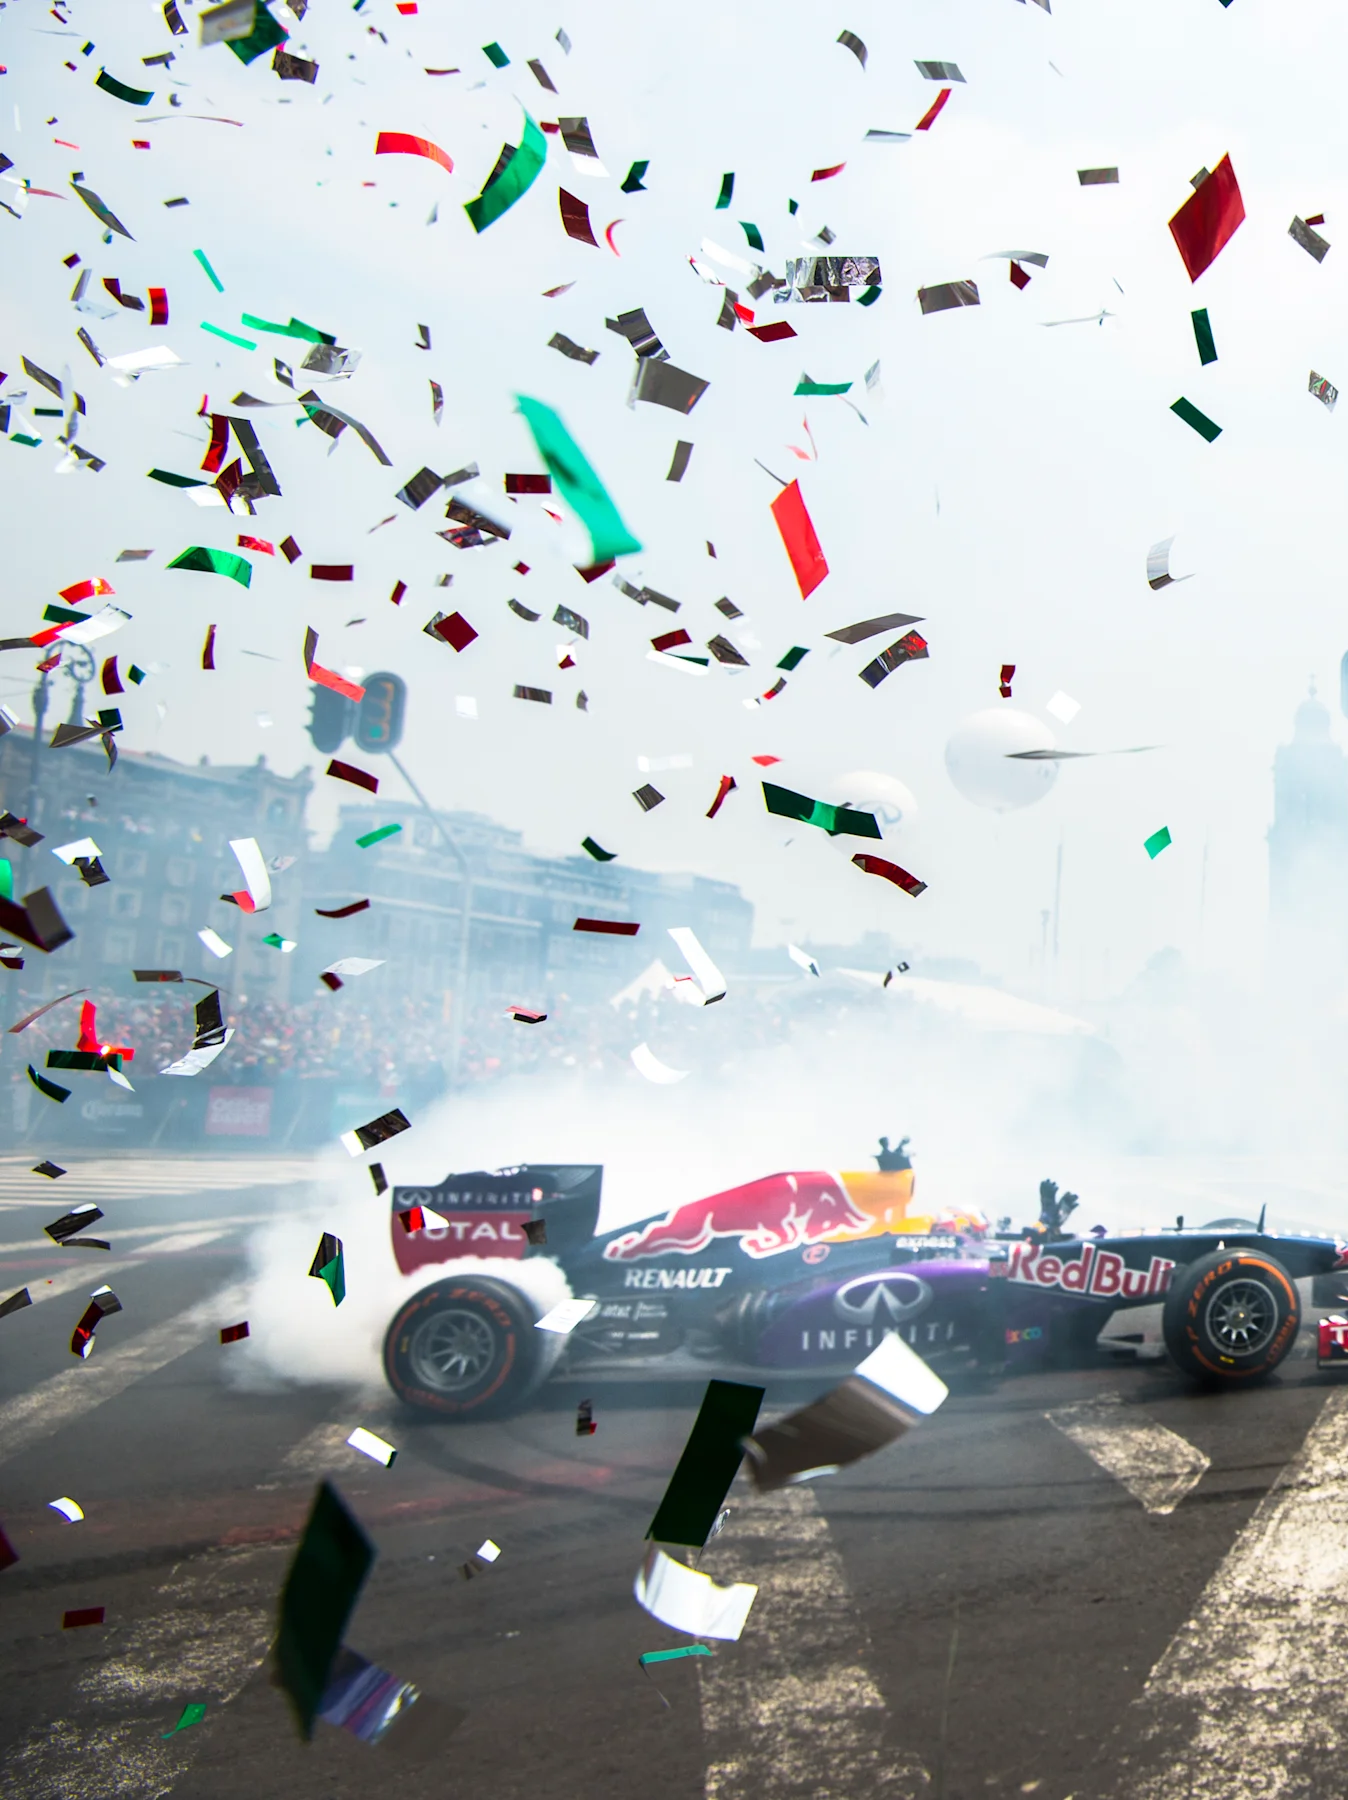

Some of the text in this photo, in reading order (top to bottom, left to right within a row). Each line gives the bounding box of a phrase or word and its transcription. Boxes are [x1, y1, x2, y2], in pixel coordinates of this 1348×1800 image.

[437, 1191, 532, 1206] INFINITI
[624, 1267, 732, 1289] RENAULT
[1007, 1242, 1176, 1299] Red Bull
[801, 1321, 955, 1351] INFIITI
